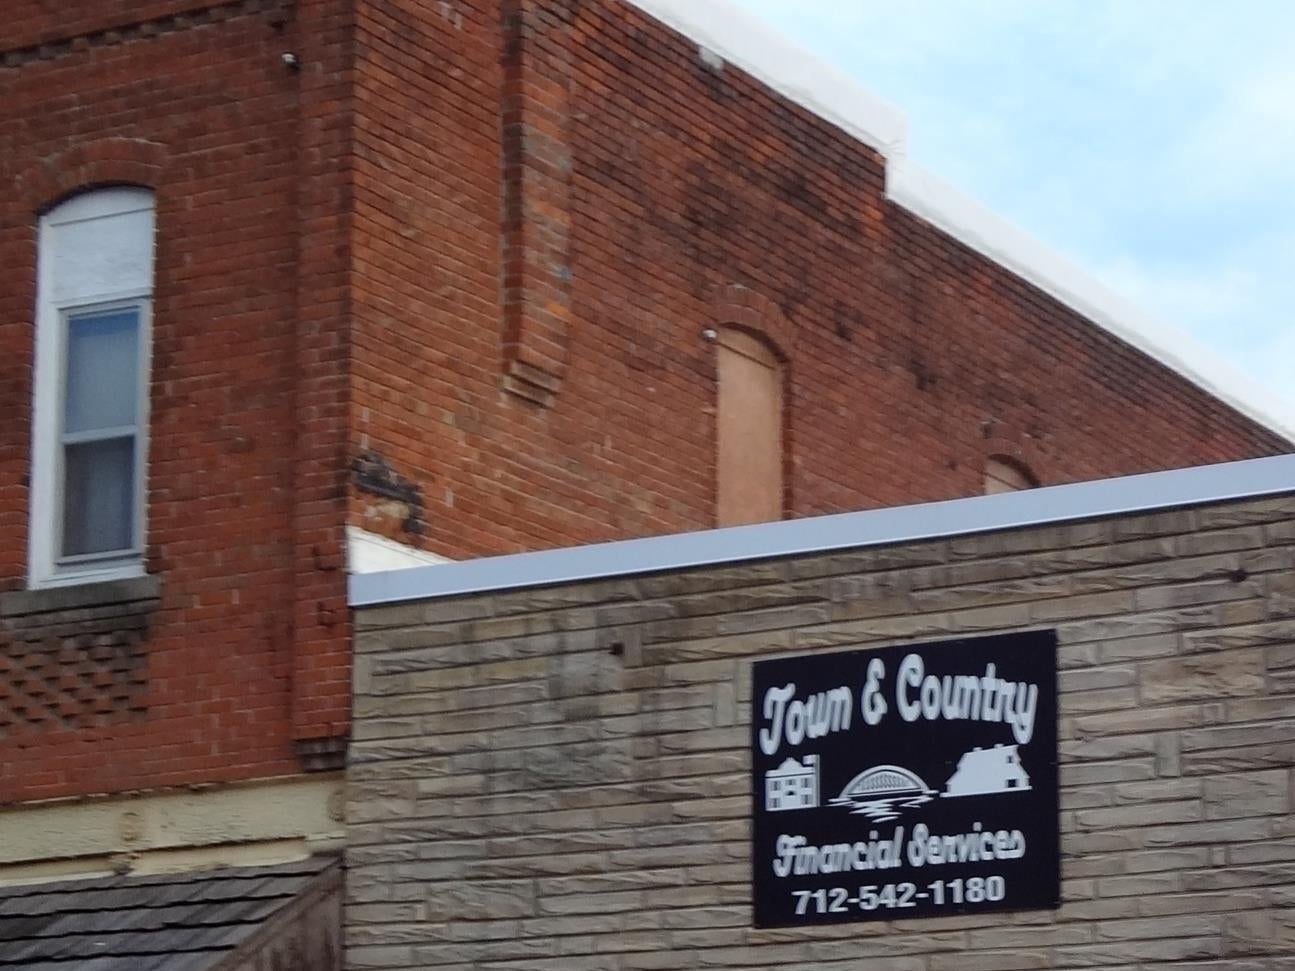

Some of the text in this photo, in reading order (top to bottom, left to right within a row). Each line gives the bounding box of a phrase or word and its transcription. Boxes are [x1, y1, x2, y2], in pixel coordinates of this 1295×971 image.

[760, 683, 853, 755] Town
[896, 653, 1039, 744] Country
[773, 821, 1026, 877] Financial Services
[791, 875, 1006, 915] 712-542-1180
